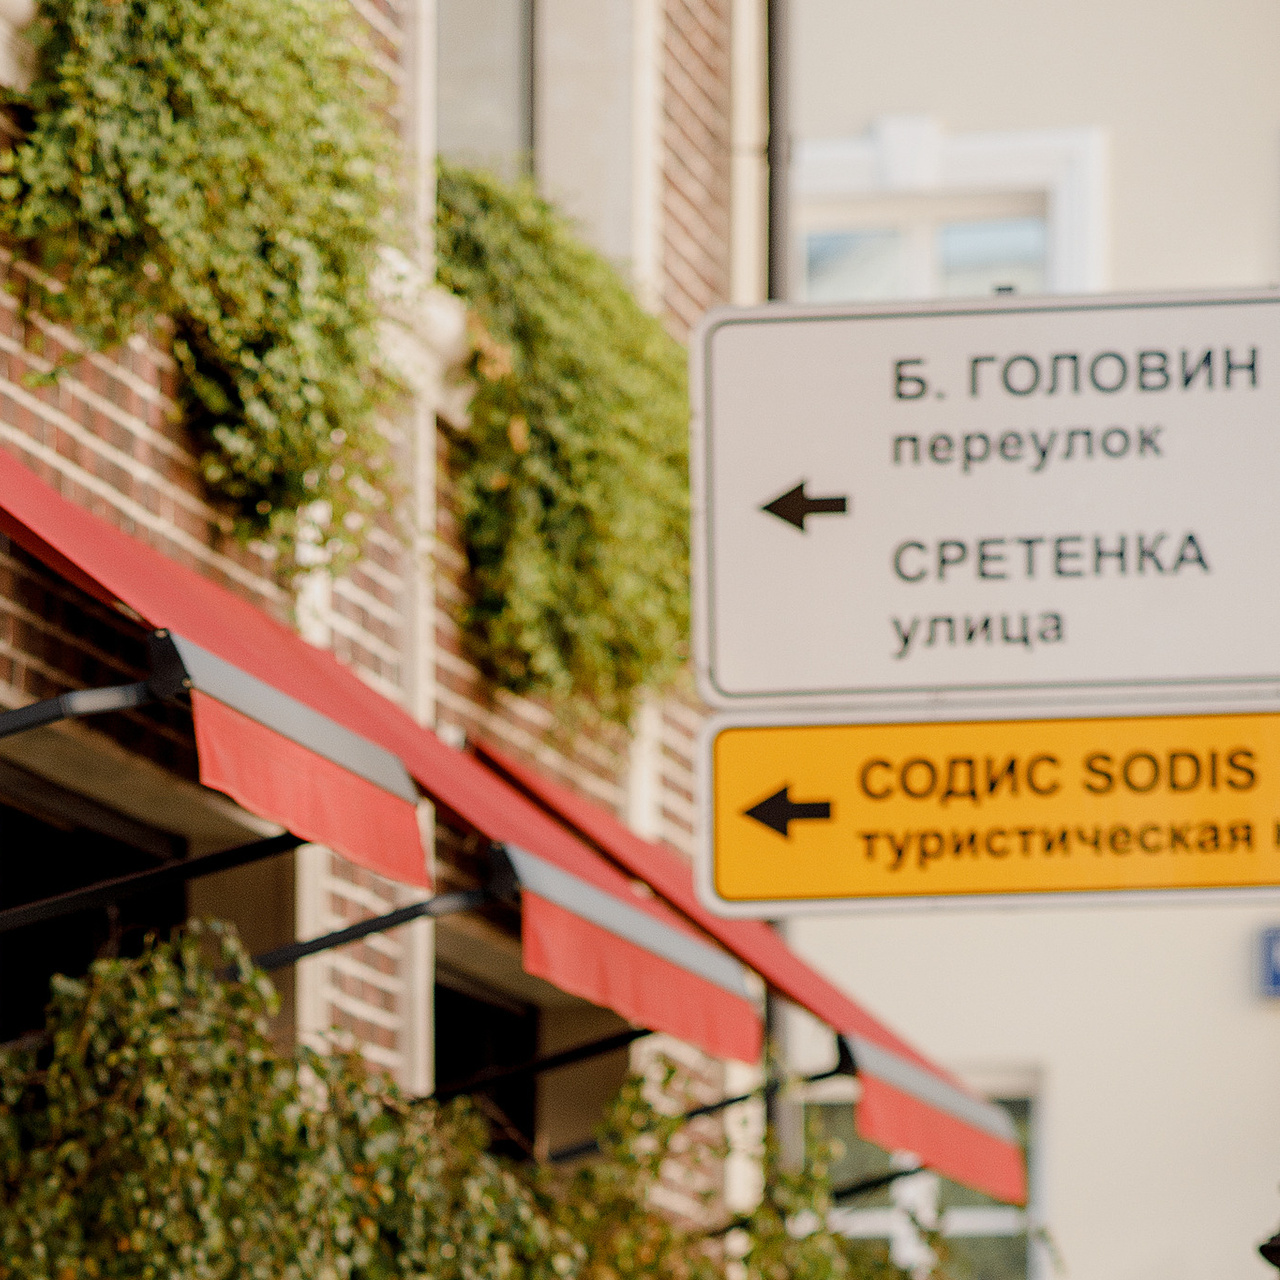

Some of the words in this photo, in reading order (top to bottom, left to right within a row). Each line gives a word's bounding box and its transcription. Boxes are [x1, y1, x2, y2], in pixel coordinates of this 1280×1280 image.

[892, 357, 946, 402] Б.
[969, 346, 1261, 398] ГОЛОВИН
[891, 424, 1166, 474] переулок
[892, 532, 1212, 585] СРЕТЕНКА
[891, 611, 1066, 660] улица
[857, 752, 1063, 806] СОДИС
[1082, 748, 1259, 797] SODIS
[857, 815, 1255, 873] туристическая
